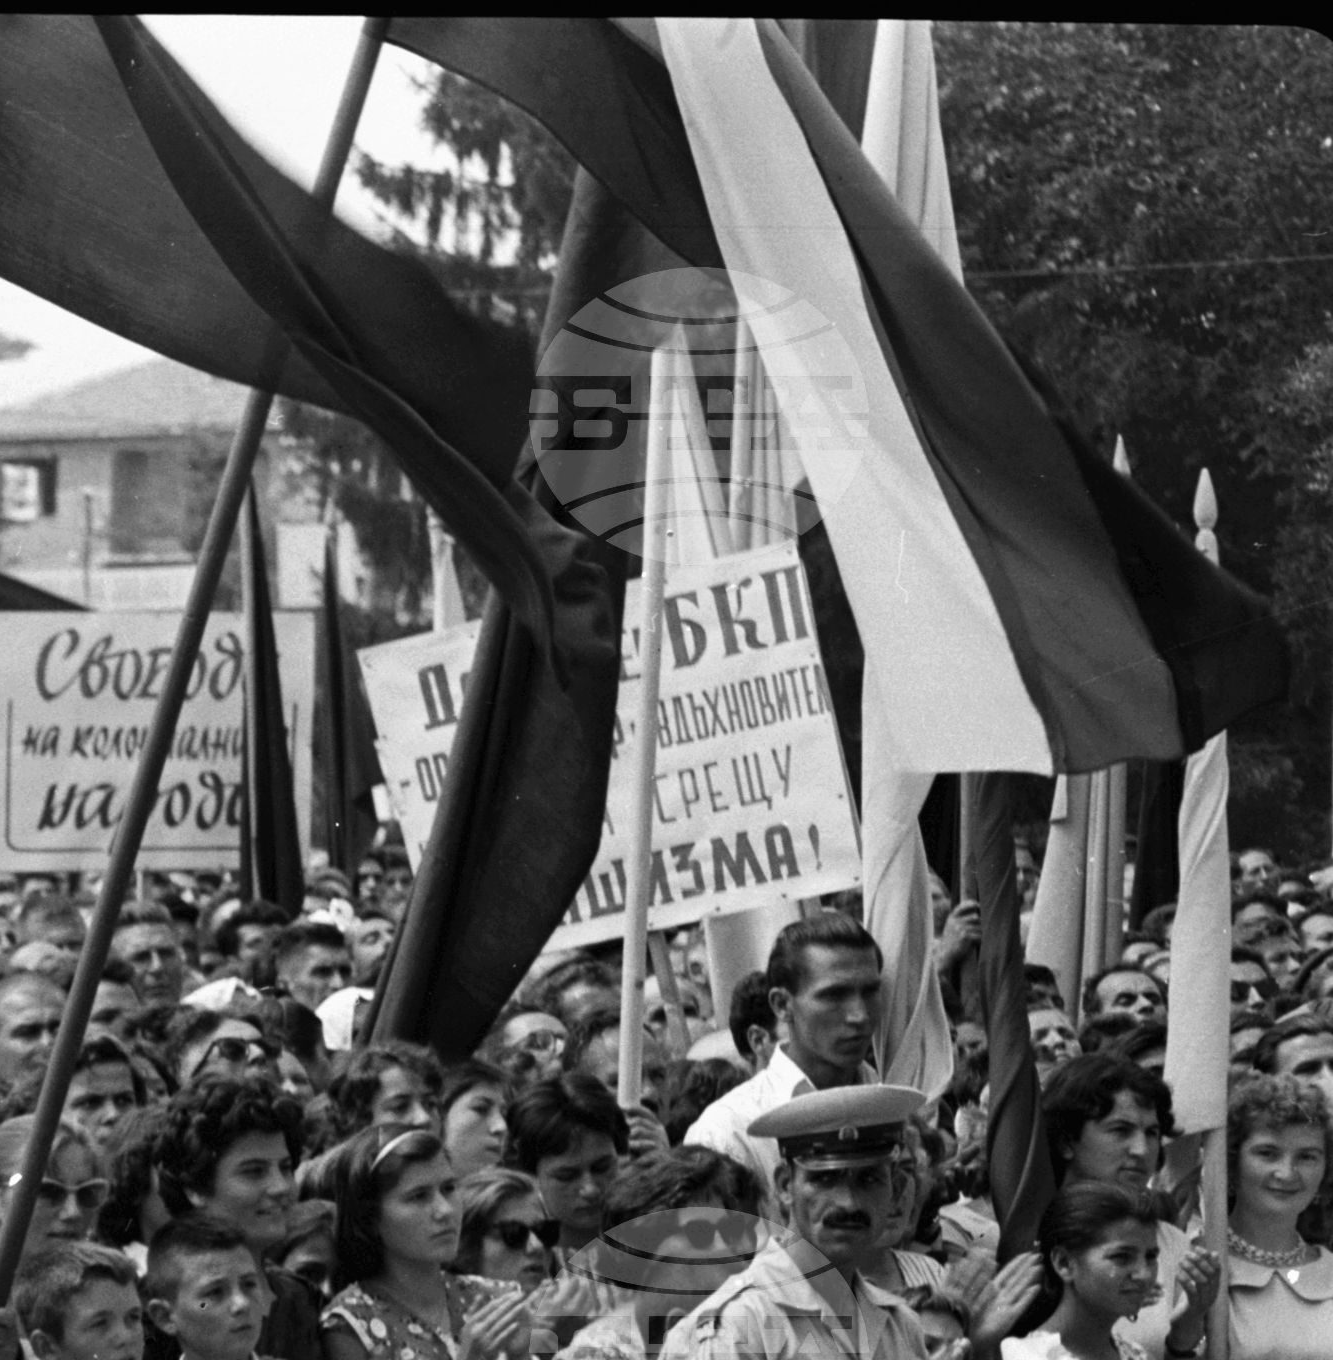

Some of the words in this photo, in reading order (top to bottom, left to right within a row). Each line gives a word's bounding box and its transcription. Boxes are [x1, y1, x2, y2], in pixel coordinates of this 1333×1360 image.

[35, 628, 245, 702] Свобод
[419, 663, 471, 732] Д
[663, 565, 809, 670] БКП
[23, 725, 60, 758] на
[653, 745, 791, 823] СРЕЩУ
